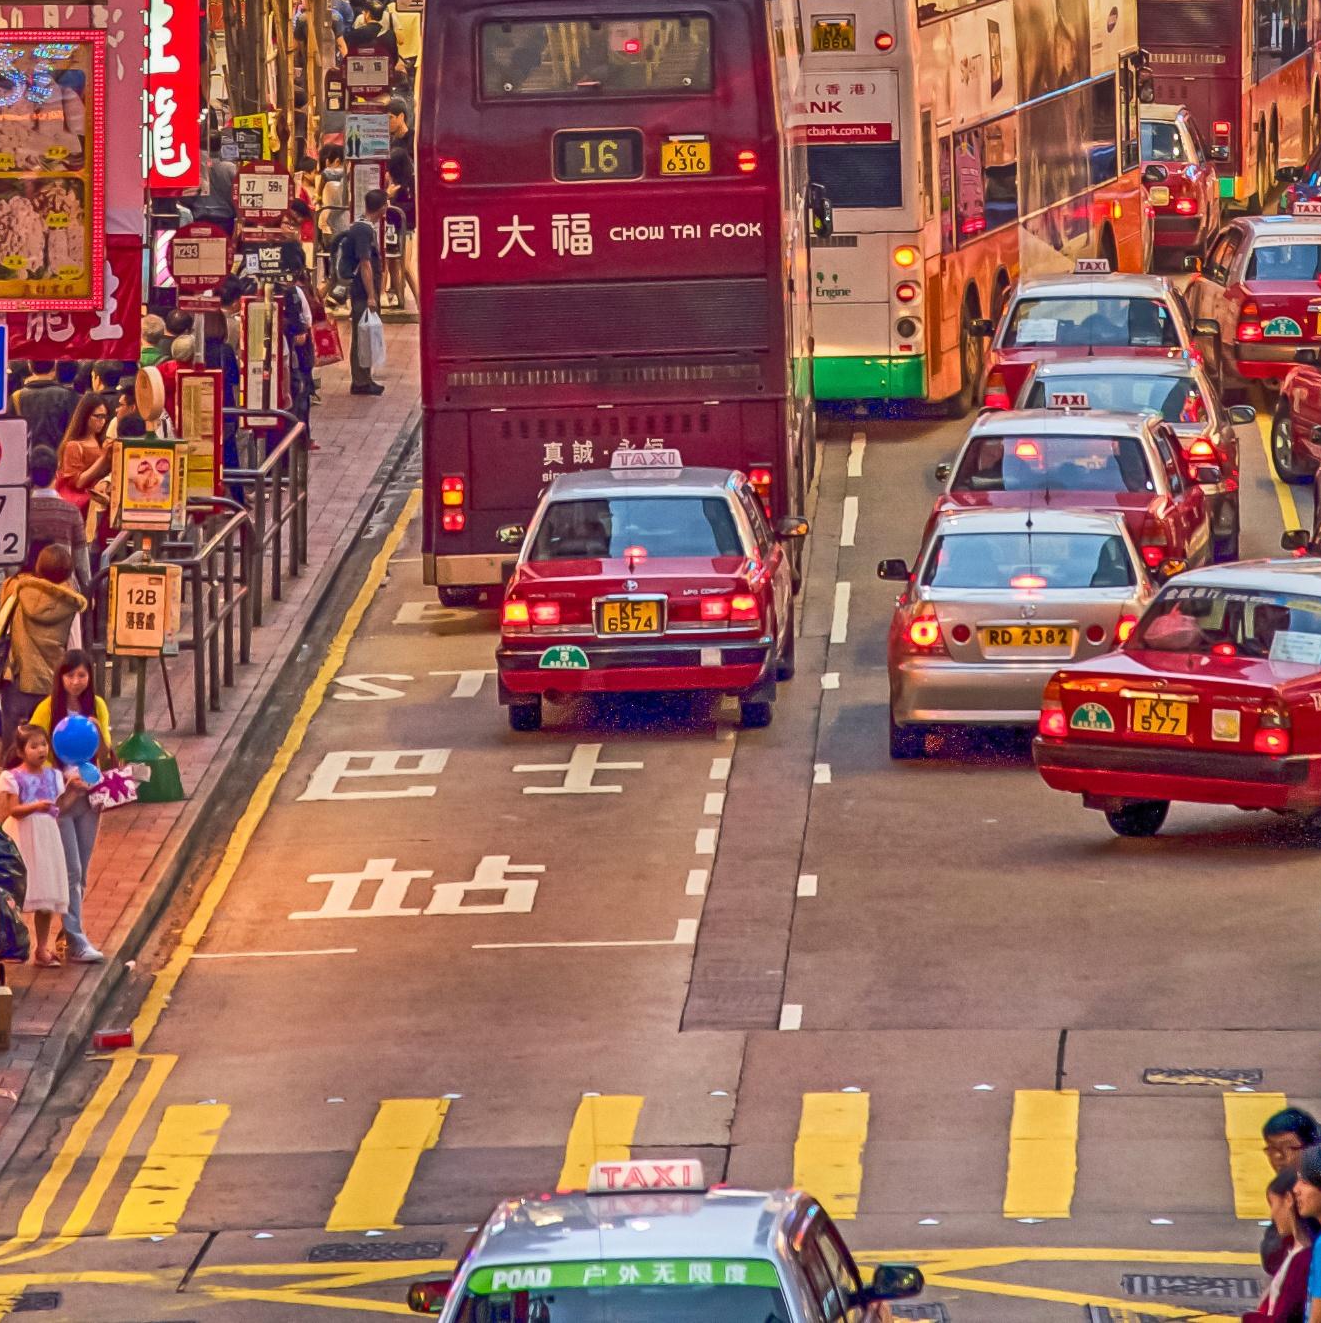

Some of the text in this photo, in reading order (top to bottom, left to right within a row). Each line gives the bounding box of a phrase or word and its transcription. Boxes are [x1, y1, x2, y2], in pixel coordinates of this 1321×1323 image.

[579, 140, 619, 173] 16
[674, 143, 699, 158] KG
[666, 158, 706, 172] 6316
[441, 213, 594, 259] 周大福
[609, 222, 762, 242] CHOW TAI FOOK
[1079, 260, 1108, 272] TAXI
[816, 285, 851, 299] Engine
[1052, 394, 1086, 406] TAXI
[617, 452, 676, 466] TAXI
[127, 589, 156, 605] 12B
[607, 617, 654, 632] 6574
[986, 628, 1070, 648] RD 2382
[1148, 700, 1174, 719] KT
[1141, 717, 1181, 733] 577
[296, 743, 644, 801] 巴士
[288, 855, 545, 918] 站
[600, 1165, 692, 1189] TAXI
[492, 1268, 551, 1289] POAD
